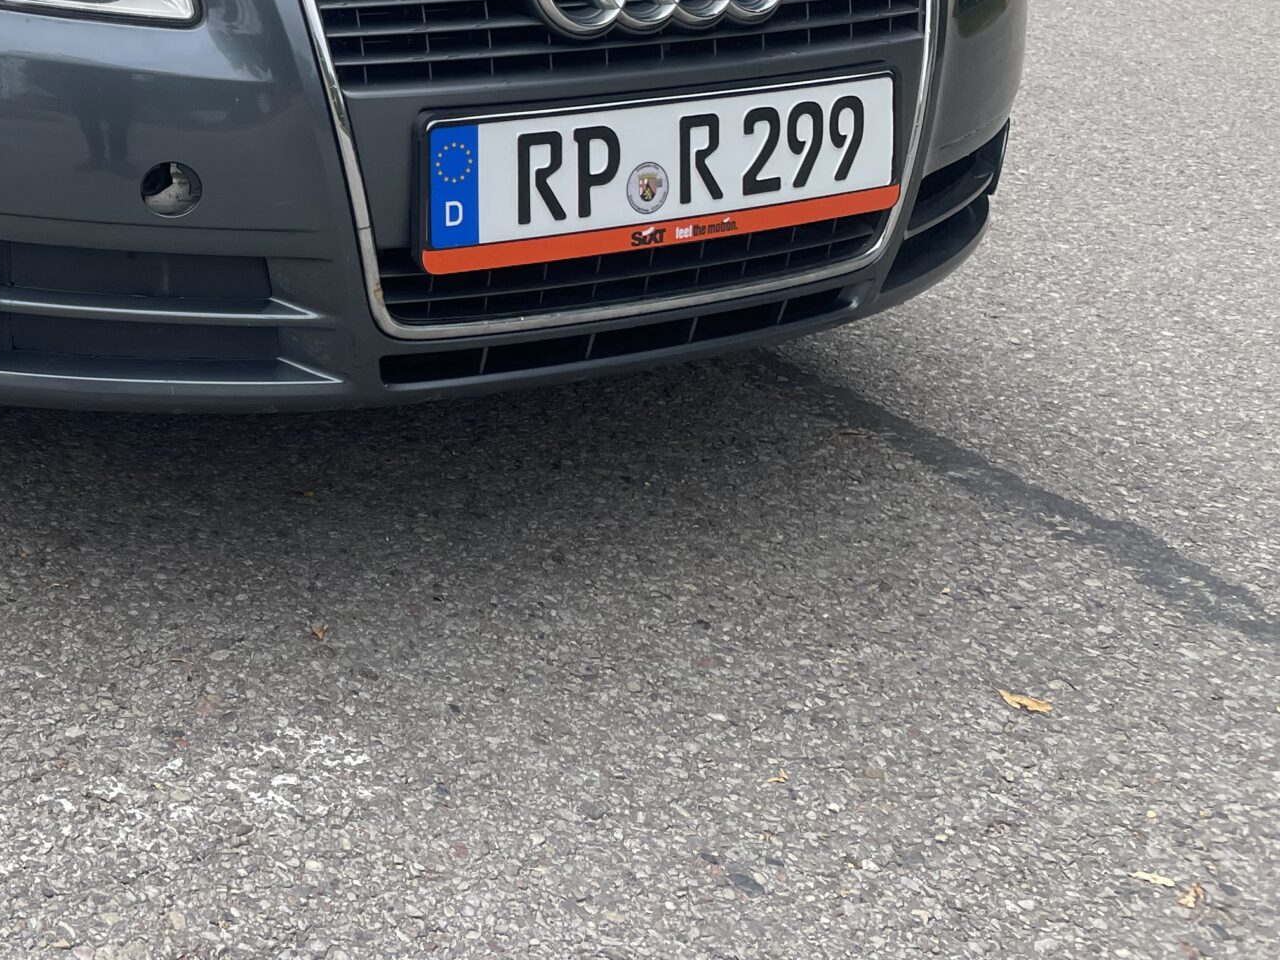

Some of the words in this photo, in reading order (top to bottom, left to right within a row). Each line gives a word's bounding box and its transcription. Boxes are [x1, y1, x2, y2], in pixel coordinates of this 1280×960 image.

[517, 125, 621, 226] RP
[679, 112, 724, 205] R
[742, 95, 865, 197] 299
[445, 201, 463, 227] D
